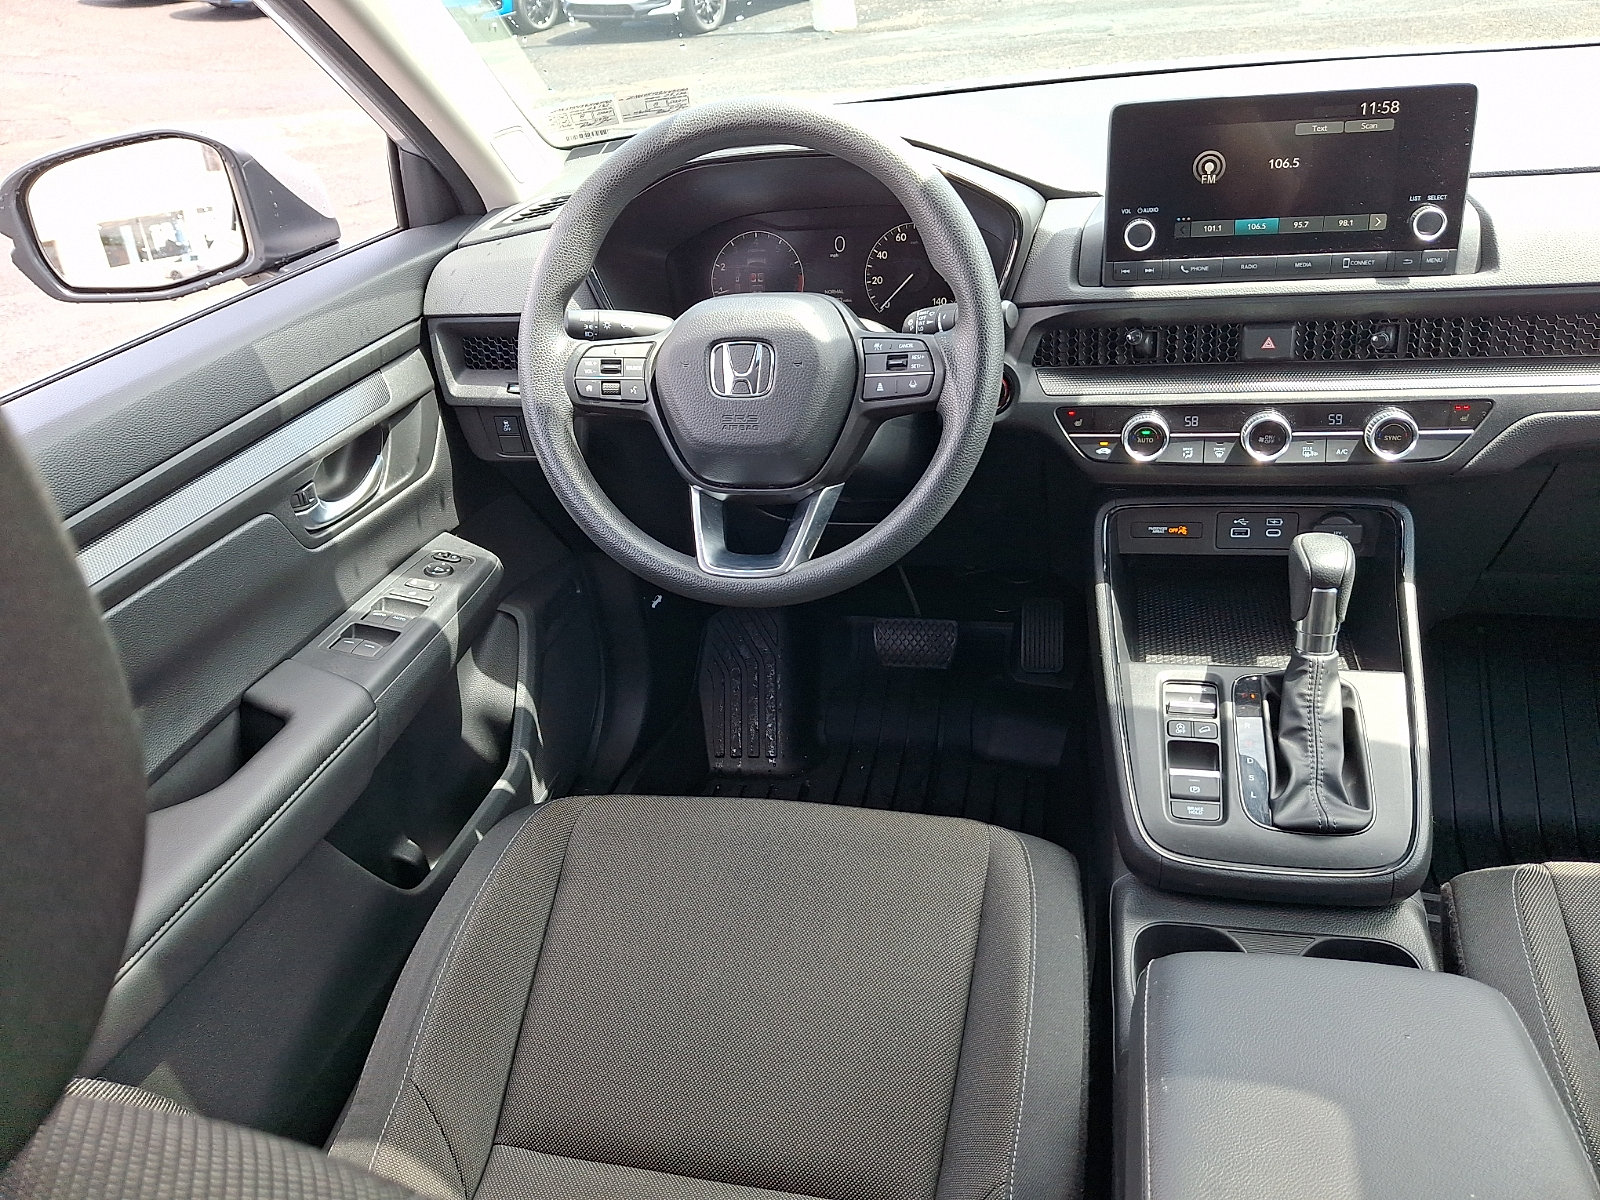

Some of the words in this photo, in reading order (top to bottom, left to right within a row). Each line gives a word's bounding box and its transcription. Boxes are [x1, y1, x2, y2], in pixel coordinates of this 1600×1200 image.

[1360, 100, 1400, 115] 11:58
[1312, 124, 1328, 132] Text
[1361, 122, 1378, 130] Scan
[1268, 157, 1300, 169] 106.5
[1201, 174, 1216, 184] FM
[1143, 206, 1159, 214] AUDIO
[1247, 223, 1267, 231] 106.5
[1293, 220, 1310, 228] 95.7
[1338, 219, 1354, 227] 98.1
[1203, 225, 1222, 233] 101.1
[895, 233, 907, 242] 60
[876, 251, 888, 260] 40
[1240, 263, 1258, 271] RADIO
[871, 276, 883, 285] 20
[932, 297, 947, 306] 140
[1184, 416, 1199, 427] 58
[1328, 414, 1343, 425] 59
